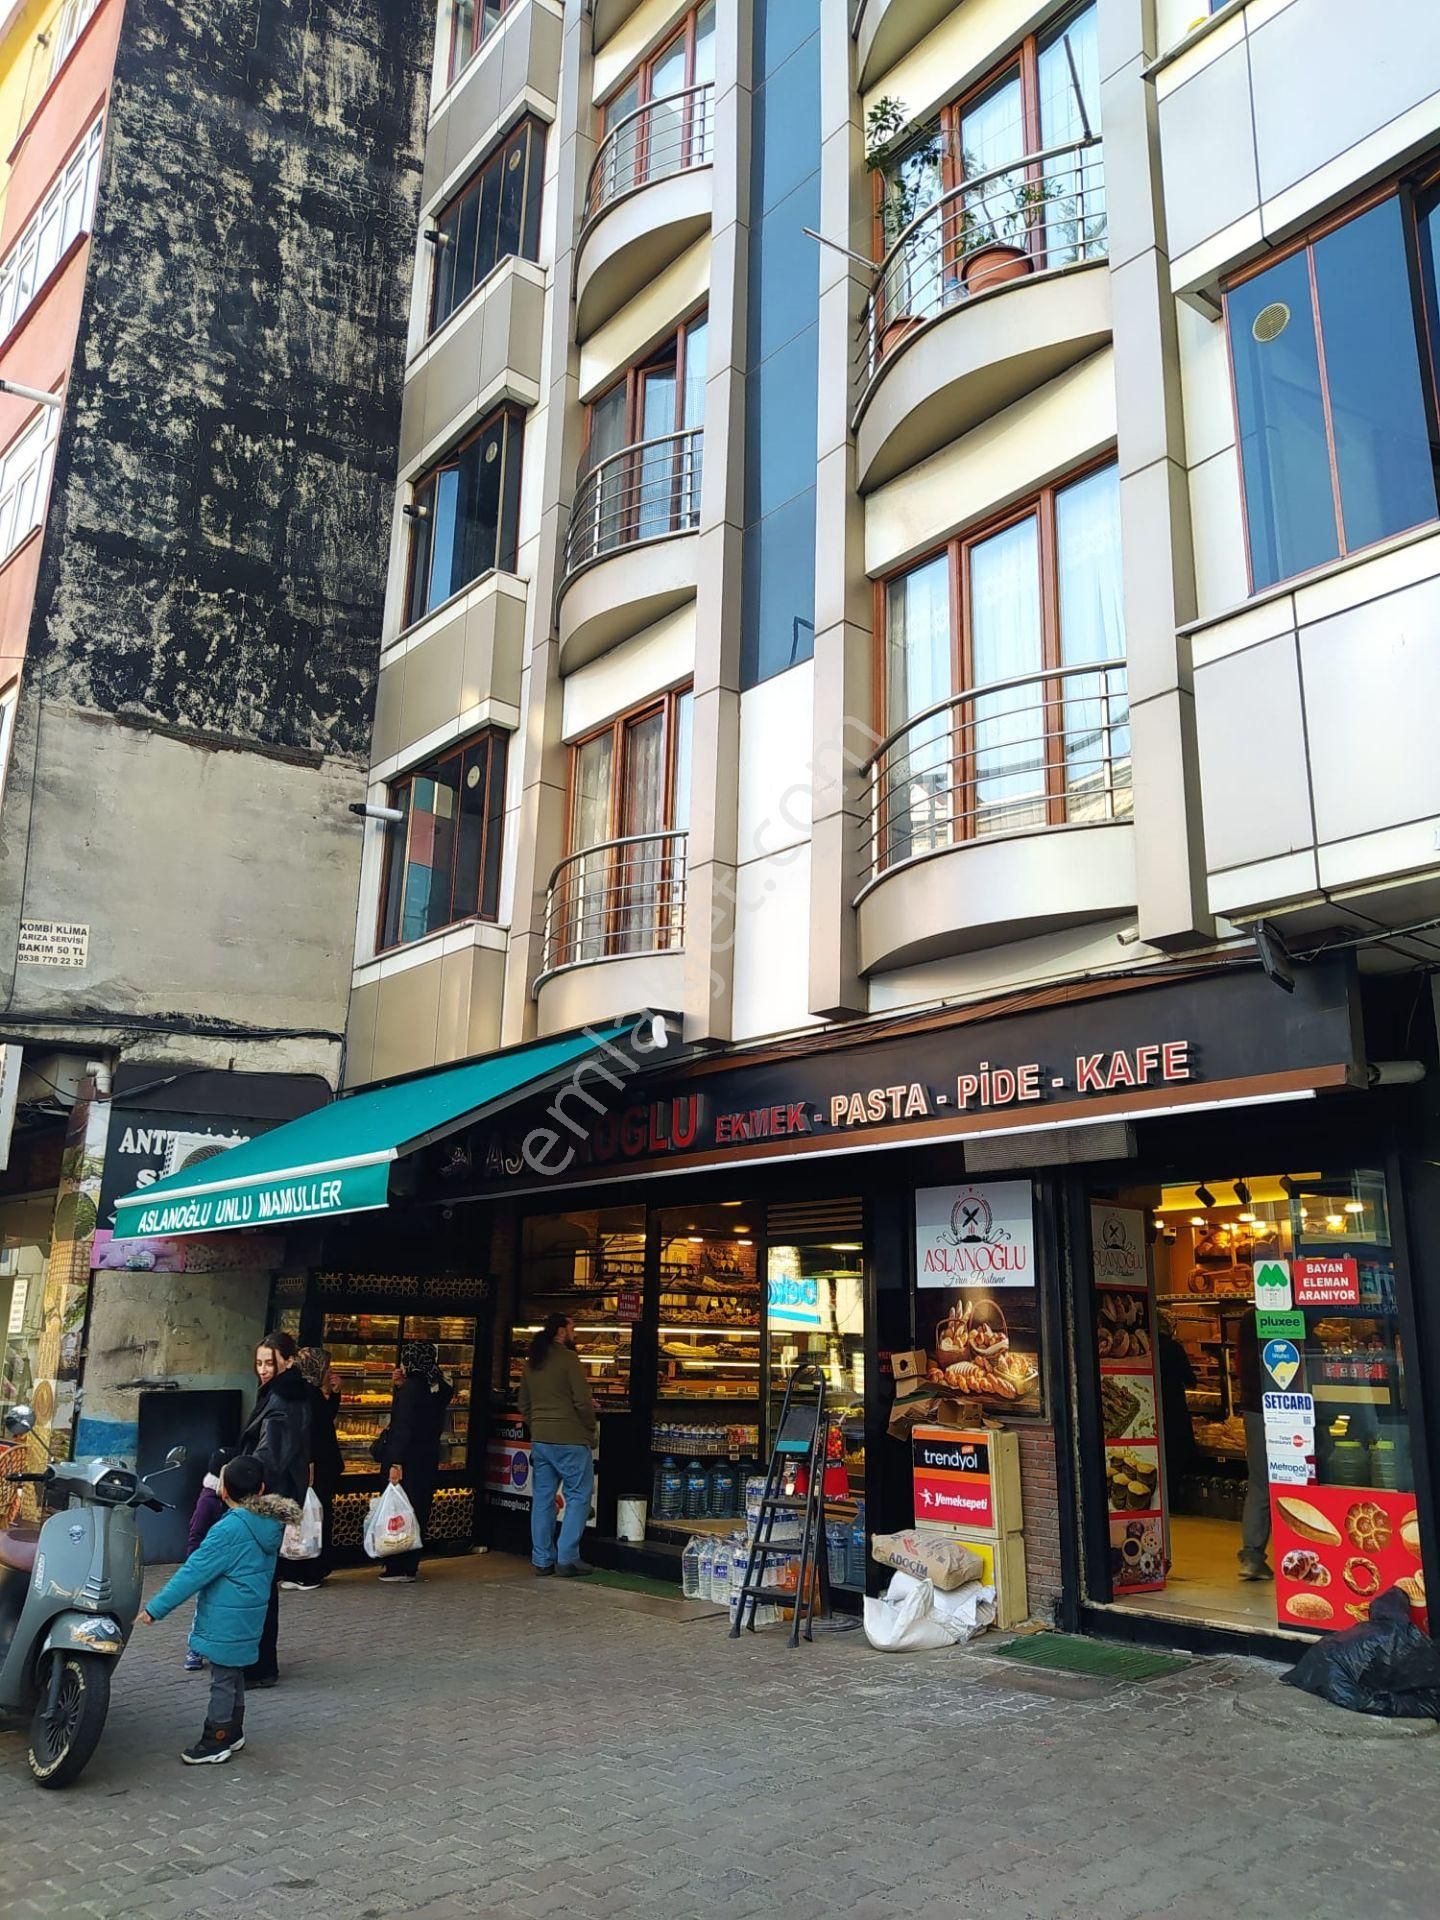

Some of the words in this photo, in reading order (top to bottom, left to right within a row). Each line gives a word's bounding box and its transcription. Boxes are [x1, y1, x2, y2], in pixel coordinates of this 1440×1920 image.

[20, 922, 53, 933] KOMBİ
[56, 925, 87, 936] KLİMA
[22, 933, 48, 941] ARIZA
[50, 935, 84, 944] SERVİSİ
[18, 943, 53, 953] BAKIM
[57, 946, 69, 954] 50
[73, 947, 84, 955] TL
[18, 954, 39, 962] 0538
[42, 955, 58, 963] 770
[73, 958, 84, 966] 32
[715, 1101, 808, 1144] EKMEK
[830, 1083, 929, 1127] PASTA
[957, 1061, 1041, 1109] PİDE
[1076, 1040, 1190, 1093] KAFE
[137, 1199, 213, 1234] ASLANOĞLU
[215, 1195, 253, 1224] UNLU
[258, 1179, 342, 1218] MAMULLER
[923, 1243, 1027, 1273] ASLANOĞLU
[1306, 1263, 1343, 1274] BAYAN
[1303, 1277, 1349, 1288] ELEMAN
[1298, 1290, 1356, 1301] ARANIYOR
[1260, 1316, 1301, 1328] pluxee
[1264, 1394, 1312, 1411] SETCARD
[924, 1449, 978, 1470] trendyol
[1269, 1461, 1306, 1474] Metropol
[889, 1552, 929, 1577] ADOÇİM
